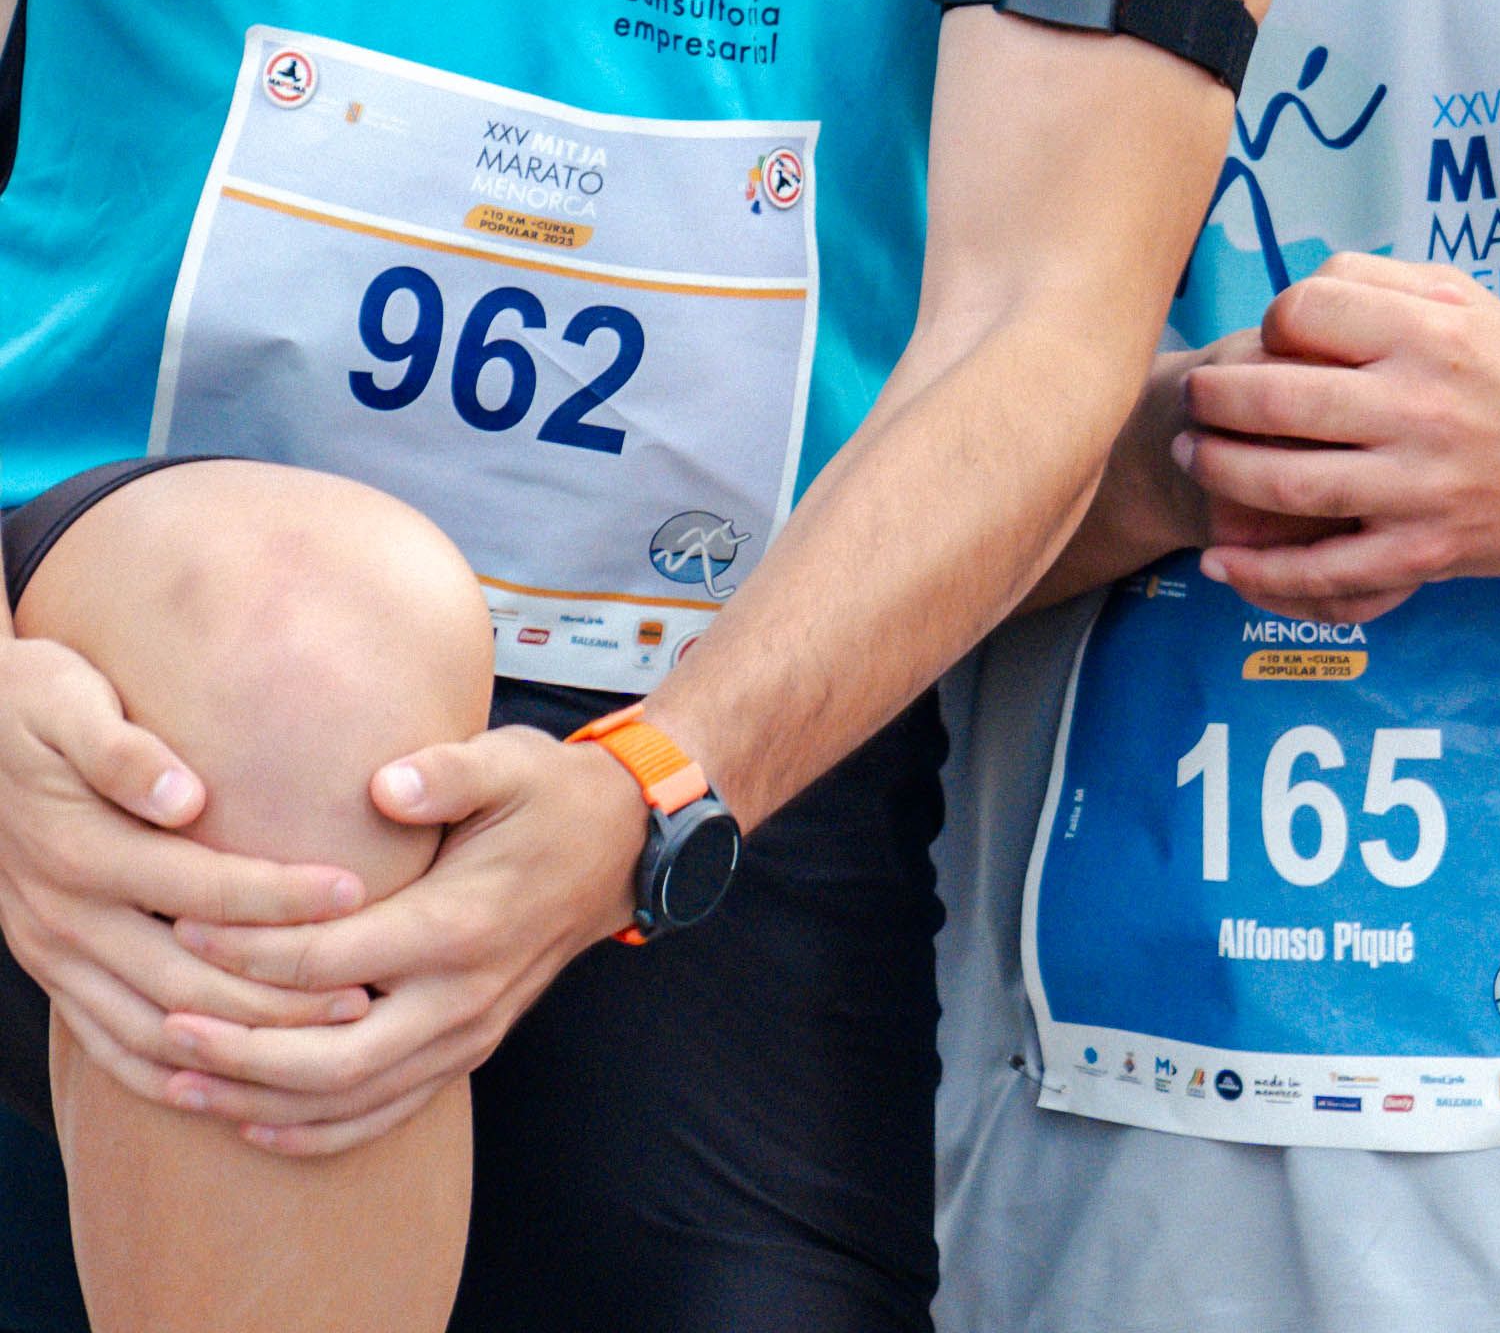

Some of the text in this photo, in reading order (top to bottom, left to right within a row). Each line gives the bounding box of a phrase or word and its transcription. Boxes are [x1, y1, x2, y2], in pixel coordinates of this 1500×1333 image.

[614, 17, 779, 65] empresarial
[483, 120, 608, 168] XXV MITJA
[475, 145, 604, 195] MARATÓ
[469, 174, 597, 220] MENORCA
[479, 219, 539, 239] POPULAR
[346, 264, 648, 456] 962
[1241, 621, 1367, 645] MENORCA
[1258, 665, 1317, 677] POPULAR
[1176, 722, 1449, 888] 165
[1218, 917, 1415, 970] Alfonso Piqué
